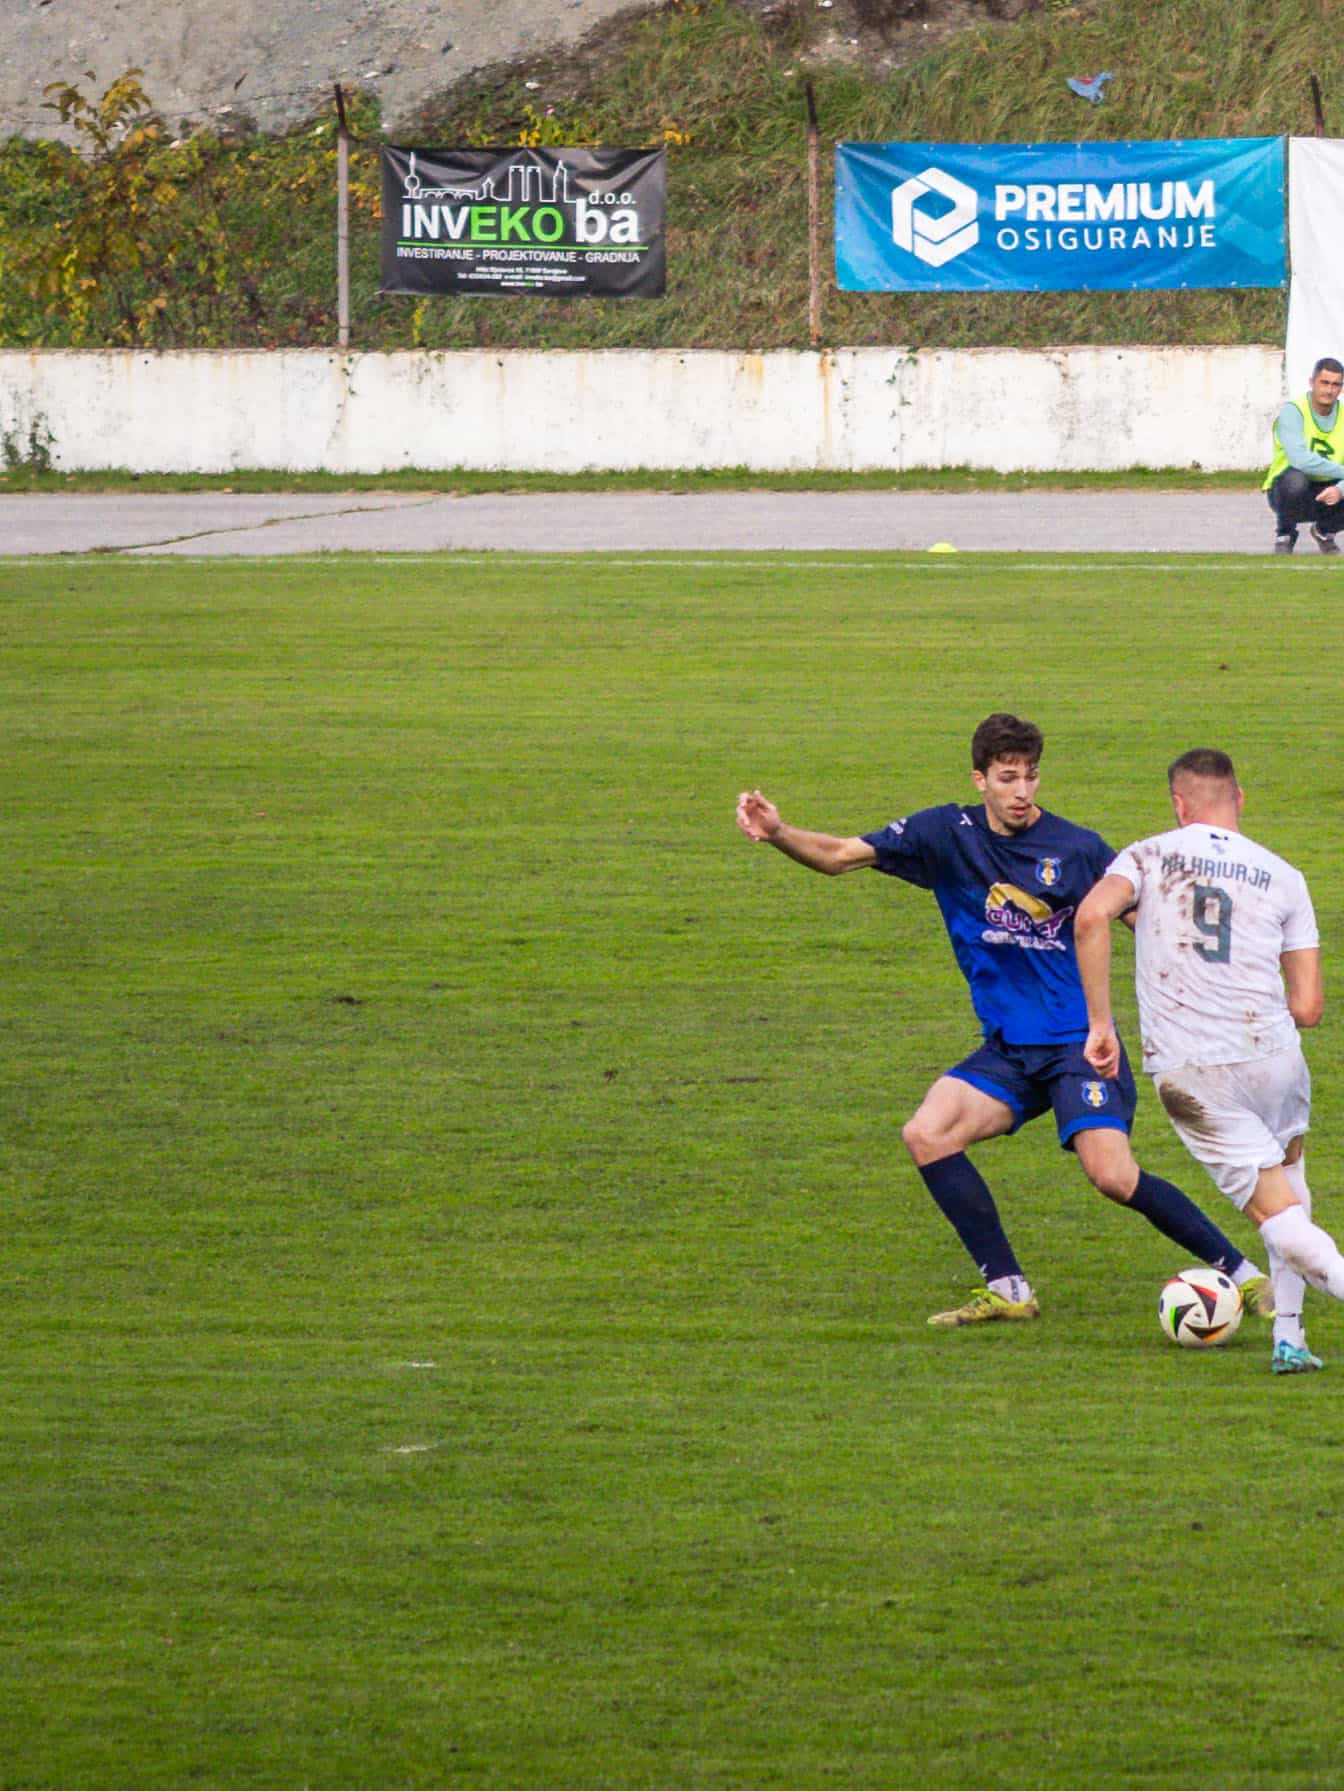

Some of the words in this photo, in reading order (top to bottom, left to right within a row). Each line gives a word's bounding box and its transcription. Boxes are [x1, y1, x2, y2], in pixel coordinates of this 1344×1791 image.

[588, 192, 637, 205] d.o.o.
[994, 180, 1216, 222] PREMIUM
[402, 204, 565, 242] INVEKO
[575, 198, 641, 243] ba
[996, 225, 1217, 251] OSIGURANJE
[396, 247, 474, 262] INVESTIRANJE
[482, 250, 577, 264] PROJEKTOVANJE
[585, 252, 641, 264] GRADNJA
[1192, 884, 1233, 965] 9
